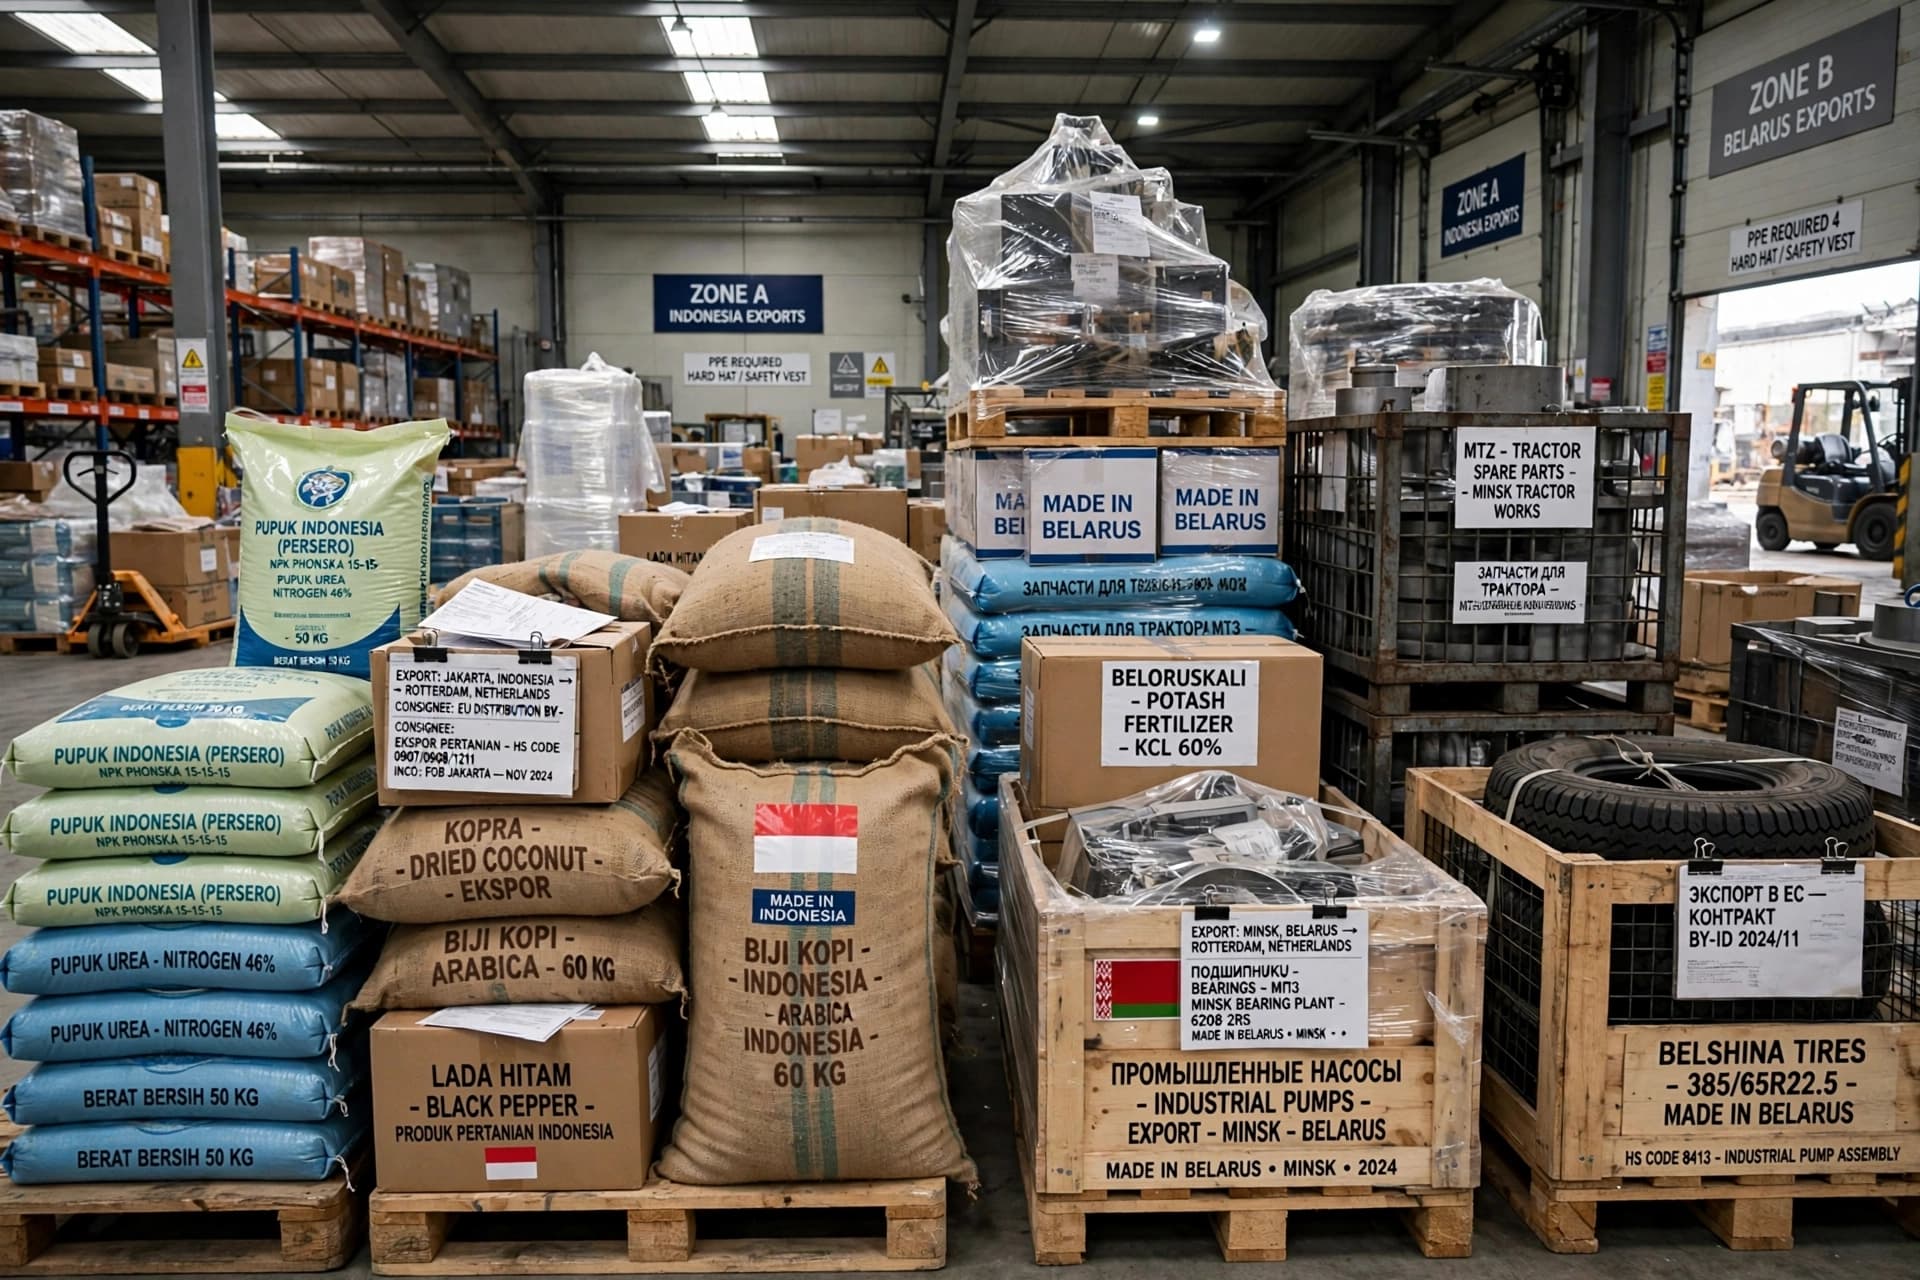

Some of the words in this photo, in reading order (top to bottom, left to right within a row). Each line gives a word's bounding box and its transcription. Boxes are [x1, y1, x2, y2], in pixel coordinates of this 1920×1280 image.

[1747, 62, 1809, 115] ZONE
[1816, 54, 1833, 89] B
[1724, 116, 1791, 158] BELARUS
[1796, 83, 1876, 134] EXPORTS
[1457, 182, 1488, 216] ZONE
[1490, 178, 1499, 204] A
[1747, 228, 1768, 248] PPE
[1771, 214, 1829, 243] REQUIRED
[1731, 253, 1757, 272] HARD
[1760, 248, 1777, 266] HAT
[1786, 237, 1824, 261] SAFETY
[1828, 231, 1855, 252] VEST
[690, 284, 748, 304] ZONE
[753, 284, 769, 304] A
[669, 309, 743, 323] INDONESIA
[747, 310, 805, 323] EXPORTS
[708, 357, 729, 367] PPE
[731, 357, 782, 368] REQUIRED
[688, 371, 715, 381] HARD
[718, 371, 736, 381] HAT
[745, 371, 780, 382] SAFETY
[783, 371, 806, 381] VEST
[1464, 442, 1495, 459] MTZ
[1512, 442, 1581, 459] TRACTOR
[1474, 464, 1516, 479] SPARE
[1521, 464, 1564, 479] PARTS
[1472, 484, 1512, 500] MINSK
[1517, 484, 1575, 499] TRACTOR
[1043, 494, 1105, 513] MADE
[1112, 494, 1132, 512] IN
[1494, 503, 1540, 519] WORKS
[256, 521, 297, 535] PUPUK
[302, 521, 384, 536] INDONESIA
[1042, 520, 1141, 539] BELARUS
[278, 539, 354, 557] (PERSERO)
[270, 559, 289, 569] NPK
[293, 559, 343, 569] PHONSKA
[278, 575, 312, 584] PUPUK
[316, 575, 345, 584] UREA
[1478, 566, 1538, 579] ЗАПЧАСТИ
[1541, 566, 1565, 580] ДЛЯ
[273, 589, 327, 598] NITROGEN
[330, 589, 352, 598] 46%
[1024, 580, 1094, 596] ЗАПЧАСТИ
[1099, 579, 1125, 597] ДЛЯ
[1481, 583, 1545, 596] ТРАКТОРА
[1213, 621, 1240, 635] МТЗ
[295, 632, 308, 644] 50
[313, 633, 328, 644] KG
[396, 670, 441, 681] EXPORT:
[444, 671, 495, 684] JAKARTA,
[498, 673, 554, 686] INDONESIA
[1112, 669, 1246, 687] BELORUSKALI
[406, 685, 472, 698] ROTTERDAM,
[475, 687, 550, 699] NETHERLANDS
[1147, 692, 1224, 709] POTASH
[395, 702, 454, 713] CONSIGNEE:
[458, 704, 471, 714] EU
[395, 722, 454, 734] CONSIGNEE:
[1124, 716, 1233, 733] FERTILIZER
[395, 738, 436, 748] EKSPOR
[440, 739, 500, 750] PERTANIAN
[514, 742, 526, 751] HS
[531, 742, 560, 753] CODE
[1135, 739, 1171, 756] KCL
[1178, 738, 1222, 756] 60%
[54, 747, 108, 765] PUPUK
[113, 745, 200, 763] INDONESIA
[205, 746, 285, 765] (PERSERO)
[100, 767, 123, 778] NPK
[126, 767, 181, 777] PHONSKA
[185, 767, 230, 778] 15-15-15
[394, 766, 423, 777] INCO:
[426, 767, 444, 777] FOB
[447, 767, 491, 778] JAKARTA
[506, 770, 527, 780] NOV
[530, 770, 553, 781] 2024
[444, 817, 522, 844] KOPRA
[410, 848, 476, 880] DRIED
[483, 846, 588, 872] COCONUT
[460, 876, 552, 902] EKSPOR
[1689, 886, 1763, 902] ЭКСПОРТ
[1768, 886, 1779, 902] В
[1784, 885, 1804, 902] ЕС
[770, 894, 814, 907] MADE
[819, 894, 834, 906] IN
[759, 908, 846, 922] INDONESIA
[1689, 908, 1775, 925] КОНТРАКТ
[1192, 926, 1239, 938] EXPORT:
[1243, 925, 1282, 939] MINSK,
[1286, 925, 1338, 936] BELARUS
[1689, 931, 1733, 947] BY-ID
[1739, 930, 1799, 947] 2024/11
[744, 937, 788, 964] BIJI
[798, 938, 853, 965] KOPI
[1192, 941, 1265, 955] ROTTERDAM,
[1268, 940, 1352, 952] NETHERLANDS
[52, 953, 103, 976] PUPUK
[108, 951, 149, 970] UREA
[164, 951, 241, 970] NITROGEN
[245, 953, 276, 973] 46%
[743, 968, 868, 997] INDONESIA
[1192, 982, 1256, 995] BEARINGS
[1192, 998, 1232, 1011] MINSK
[1236, 998, 1290, 1010] BEARING
[1295, 997, 1334, 1009] PLANT
[778, 1002, 853, 1026] ARABICA
[1191, 1014, 1222, 1026] 6208
[1227, 1014, 1250, 1026] 2RS
[743, 1027, 864, 1055] INDONESIA
[1192, 1030, 1220, 1041] MADE
[1225, 1030, 1234, 1040] IN
[1238, 1029, 1284, 1040] BELARUS
[1296, 1028, 1325, 1040] MINSK
[1660, 1040, 1784, 1065] BELSHINA
[1794, 1039, 1865, 1063] TIRES
[432, 1064, 492, 1088] LADA
[500, 1063, 571, 1087] HITAM
[774, 1062, 802, 1087] 60
[813, 1061, 846, 1087] KG
[1112, 1061, 1303, 1086] ПРОМЫШЛЕННЫЕ
[1311, 1058, 1401, 1083] НАСОСЫ
[1687, 1071, 1838, 1096] 385/65R22.5
[84, 1089, 138, 1108] BERAT
[144, 1088, 205, 1106] BERSIH
[210, 1088, 229, 1105] 50
[235, 1088, 259, 1106] KG
[427, 1095, 493, 1118] BLACK
[500, 1094, 578, 1116] PEPPER
[1154, 1091, 1277, 1116] INDUSTRIAL
[1283, 1090, 1354, 1113] PUMPS
[396, 1125, 453, 1142] PRODUK
[457, 1124, 533, 1141] PERTANIAN
[538, 1123, 614, 1140] INDONESIA
[1129, 1122, 1201, 1144] EXPORT
[1223, 1120, 1281, 1143] MINSK
[1302, 1119, 1386, 1142] BELARUS
[1625, 1151, 1642, 1165] HS
[1645, 1150, 1679, 1164] CODE
[1683, 1150, 1711, 1164] 8413
[1725, 1149, 1795, 1163] INDUSTRIAL
[1800, 1148, 1833, 1162] PUMP
[1838, 1147, 1900, 1161] ASSEMBLY
